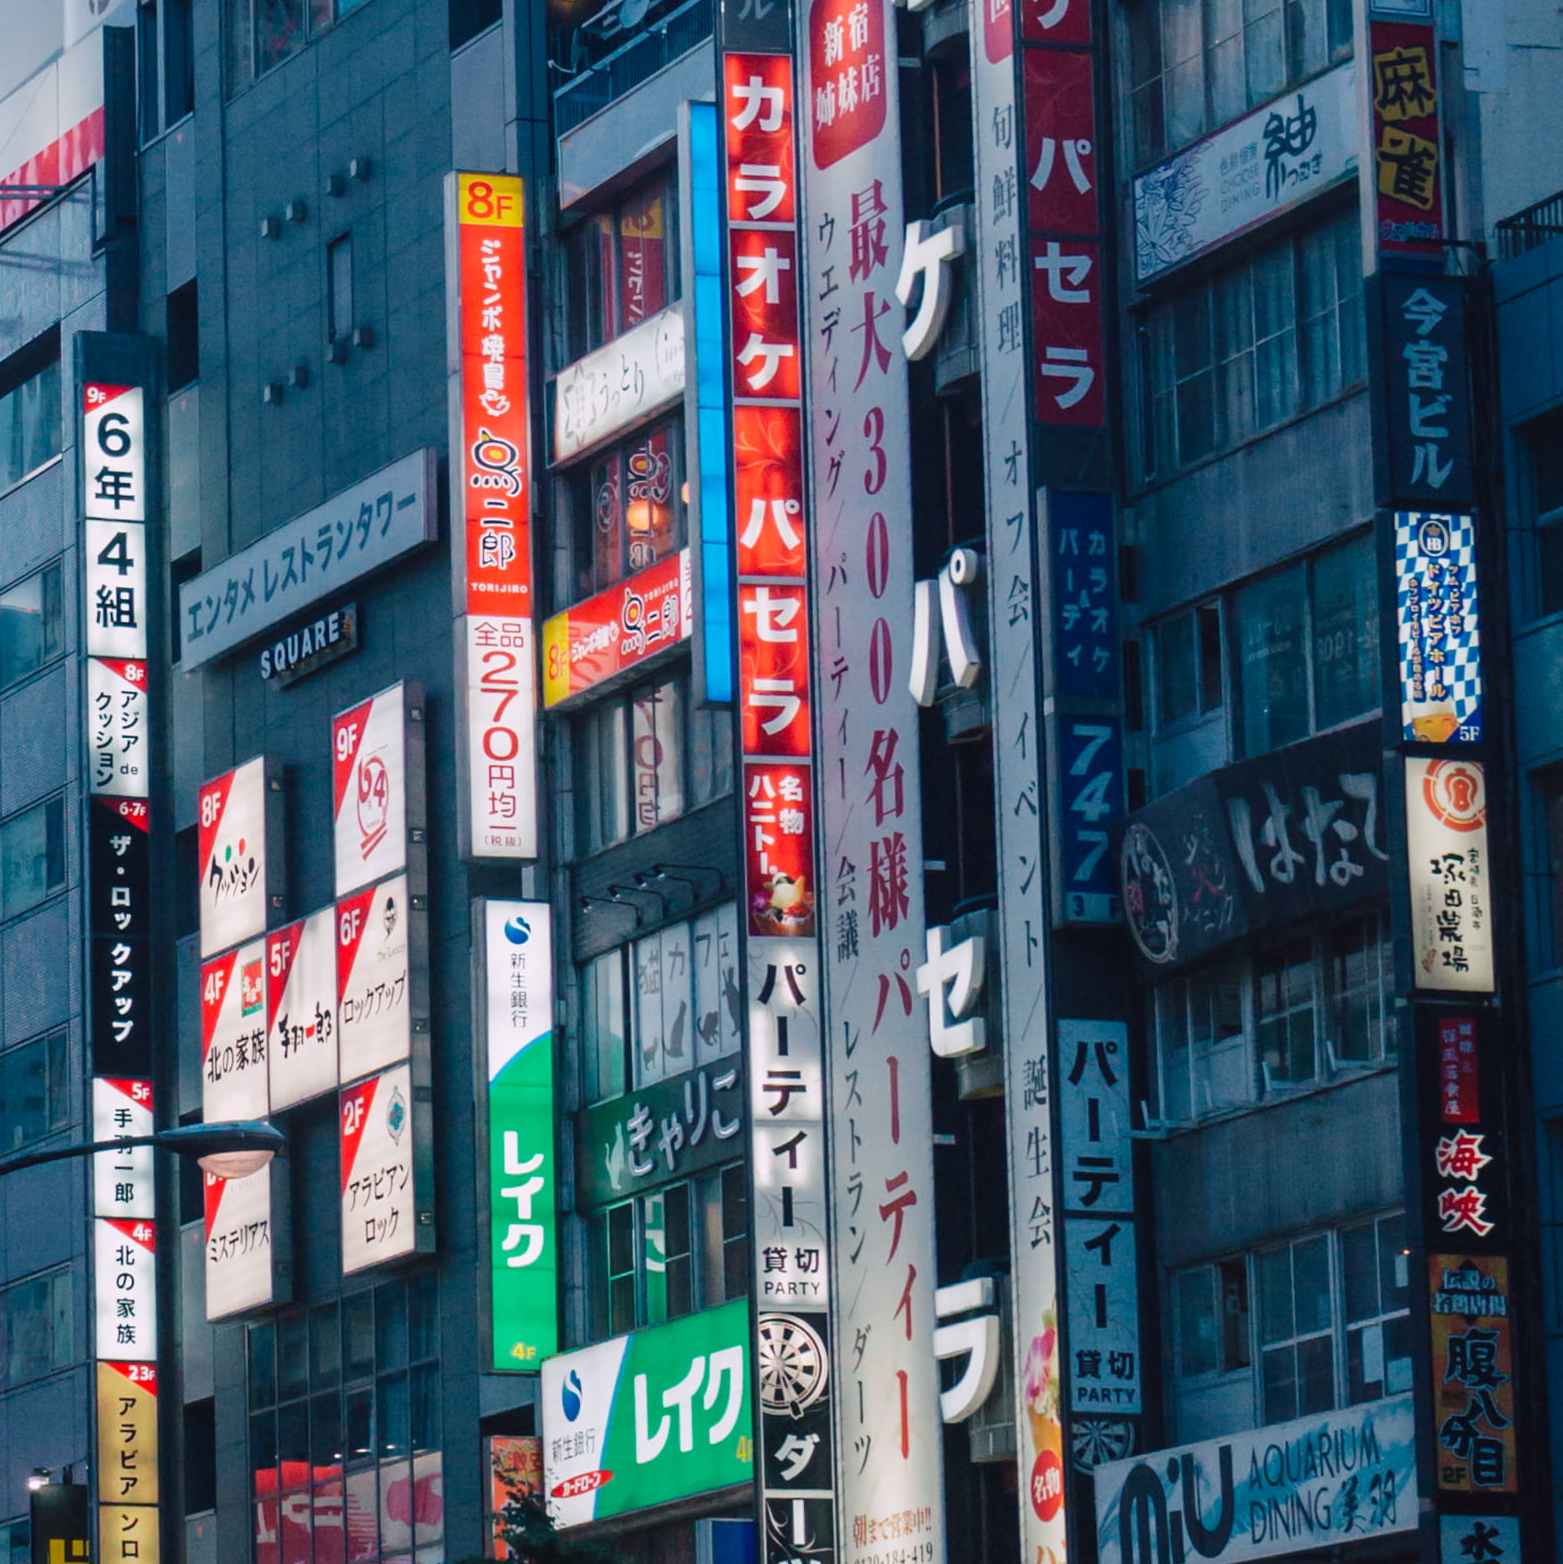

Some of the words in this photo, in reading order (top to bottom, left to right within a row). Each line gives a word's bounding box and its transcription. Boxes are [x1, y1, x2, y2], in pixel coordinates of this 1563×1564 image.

[824, 3, 868, 67] 新宿
[816, 54, 881, 133] 姉妹店
[1378, 48, 1435, 211] 麻雀
[467, 181, 513, 220] 8F
[992, 104, 1022, 355] 旬鮮料理
[88, 388, 105, 403] 9F
[731, 75, 802, 734] カラオケパセラ
[1401, 287, 1454, 489] 今宮ビル
[95, 412, 138, 628] 6年4組
[1003, 441, 1029, 627] オフ会
[471, 582, 528, 593] TORIJIRO
[644, 578, 679, 603] TORIJIRO
[1089, 532, 1111, 673] カラオケ
[260, 610, 340, 680] SQUARE
[474, 622, 524, 648] 全品
[1429, 566, 1446, 696] ドイツビアホール
[125, 666, 144, 681] 8F
[548, 644, 568, 681] 8F
[828, 548, 849, 799] パーティー
[95, 692, 114, 787] クッション
[120, 690, 139, 752] アジア
[337, 722, 358, 762] 9F
[480, 651, 519, 830] 270円均一
[1460, 727, 1480, 741] 5F
[120, 763, 138, 775] de
[201, 792, 221, 828] 8F
[779, 775, 803, 834] 名物
[848, 179, 919, 1459] 最大300名様パーティー
[1071, 724, 1111, 884] 747
[1012, 710, 1038, 969] イベント
[111, 835, 134, 1043] ザ・ロックアップ
[340, 909, 361, 946] 6F
[270, 940, 290, 976] 5F
[203, 970, 224, 1006] 4F
[343, 970, 406, 1025] ロックアップ
[510, 952, 527, 1028] 新生銀行
[207, 1027, 266, 1084] 北の家族
[132, 1083, 150, 1100] 5F
[344, 1098, 364, 1136] 2F
[758, 963, 808, 1227] パーティー
[627, 1070, 740, 1177] きゃりこ
[842, 1021, 865, 1265] レストラン
[1023, 1054, 1052, 1249] 誕生会
[349, 1164, 410, 1212] アラビアン
[502, 1130, 544, 1267] レイク
[1067, 1040, 1119, 1327] パーティー
[133, 1225, 152, 1240] 4F
[209, 1219, 269, 1263] ミステリアス
[365, 1207, 399, 1244] ロック
[761, 1246, 820, 1273] 貸切
[765, 1279, 820, 1296] PARTY
[116, 1246, 136, 1344] 北の家族
[129, 1366, 155, 1380] 23F
[510, 1342, 535, 1360] 4F
[1075, 1349, 1135, 1379] 貸切
[635, 1345, 743, 1464] レイク
[851, 1324, 872, 1476] ダーツ
[1077, 1387, 1135, 1404] PARTY
[552, 1427, 596, 1462] 新生銀行
[1249, 1426, 1379, 1489] AQUARIUM
[560, 1473, 607, 1495] カードローン
[1250, 1487, 1331, 1545] DINING
